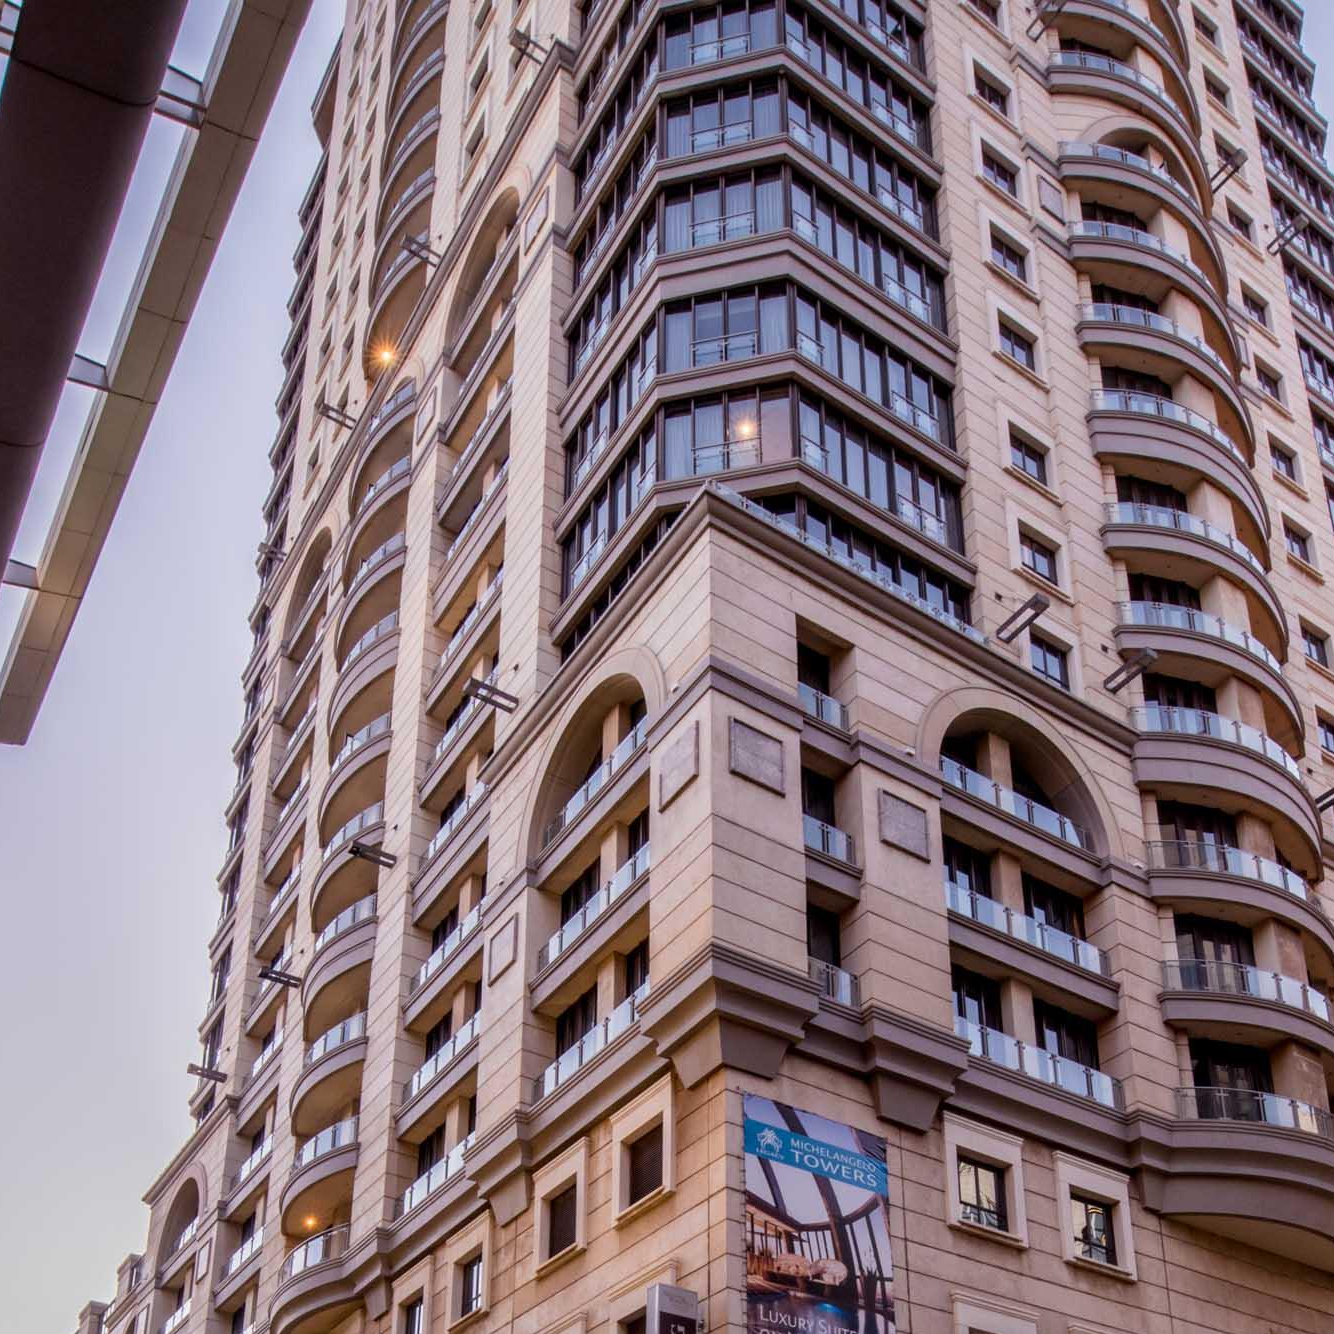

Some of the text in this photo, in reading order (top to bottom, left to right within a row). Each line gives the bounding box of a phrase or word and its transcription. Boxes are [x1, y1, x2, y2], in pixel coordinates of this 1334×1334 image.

[790, 1138, 876, 1173] MICHELANGELO
[790, 1149, 878, 1187] TOWERS
[759, 1303, 814, 1333] LUXURY
